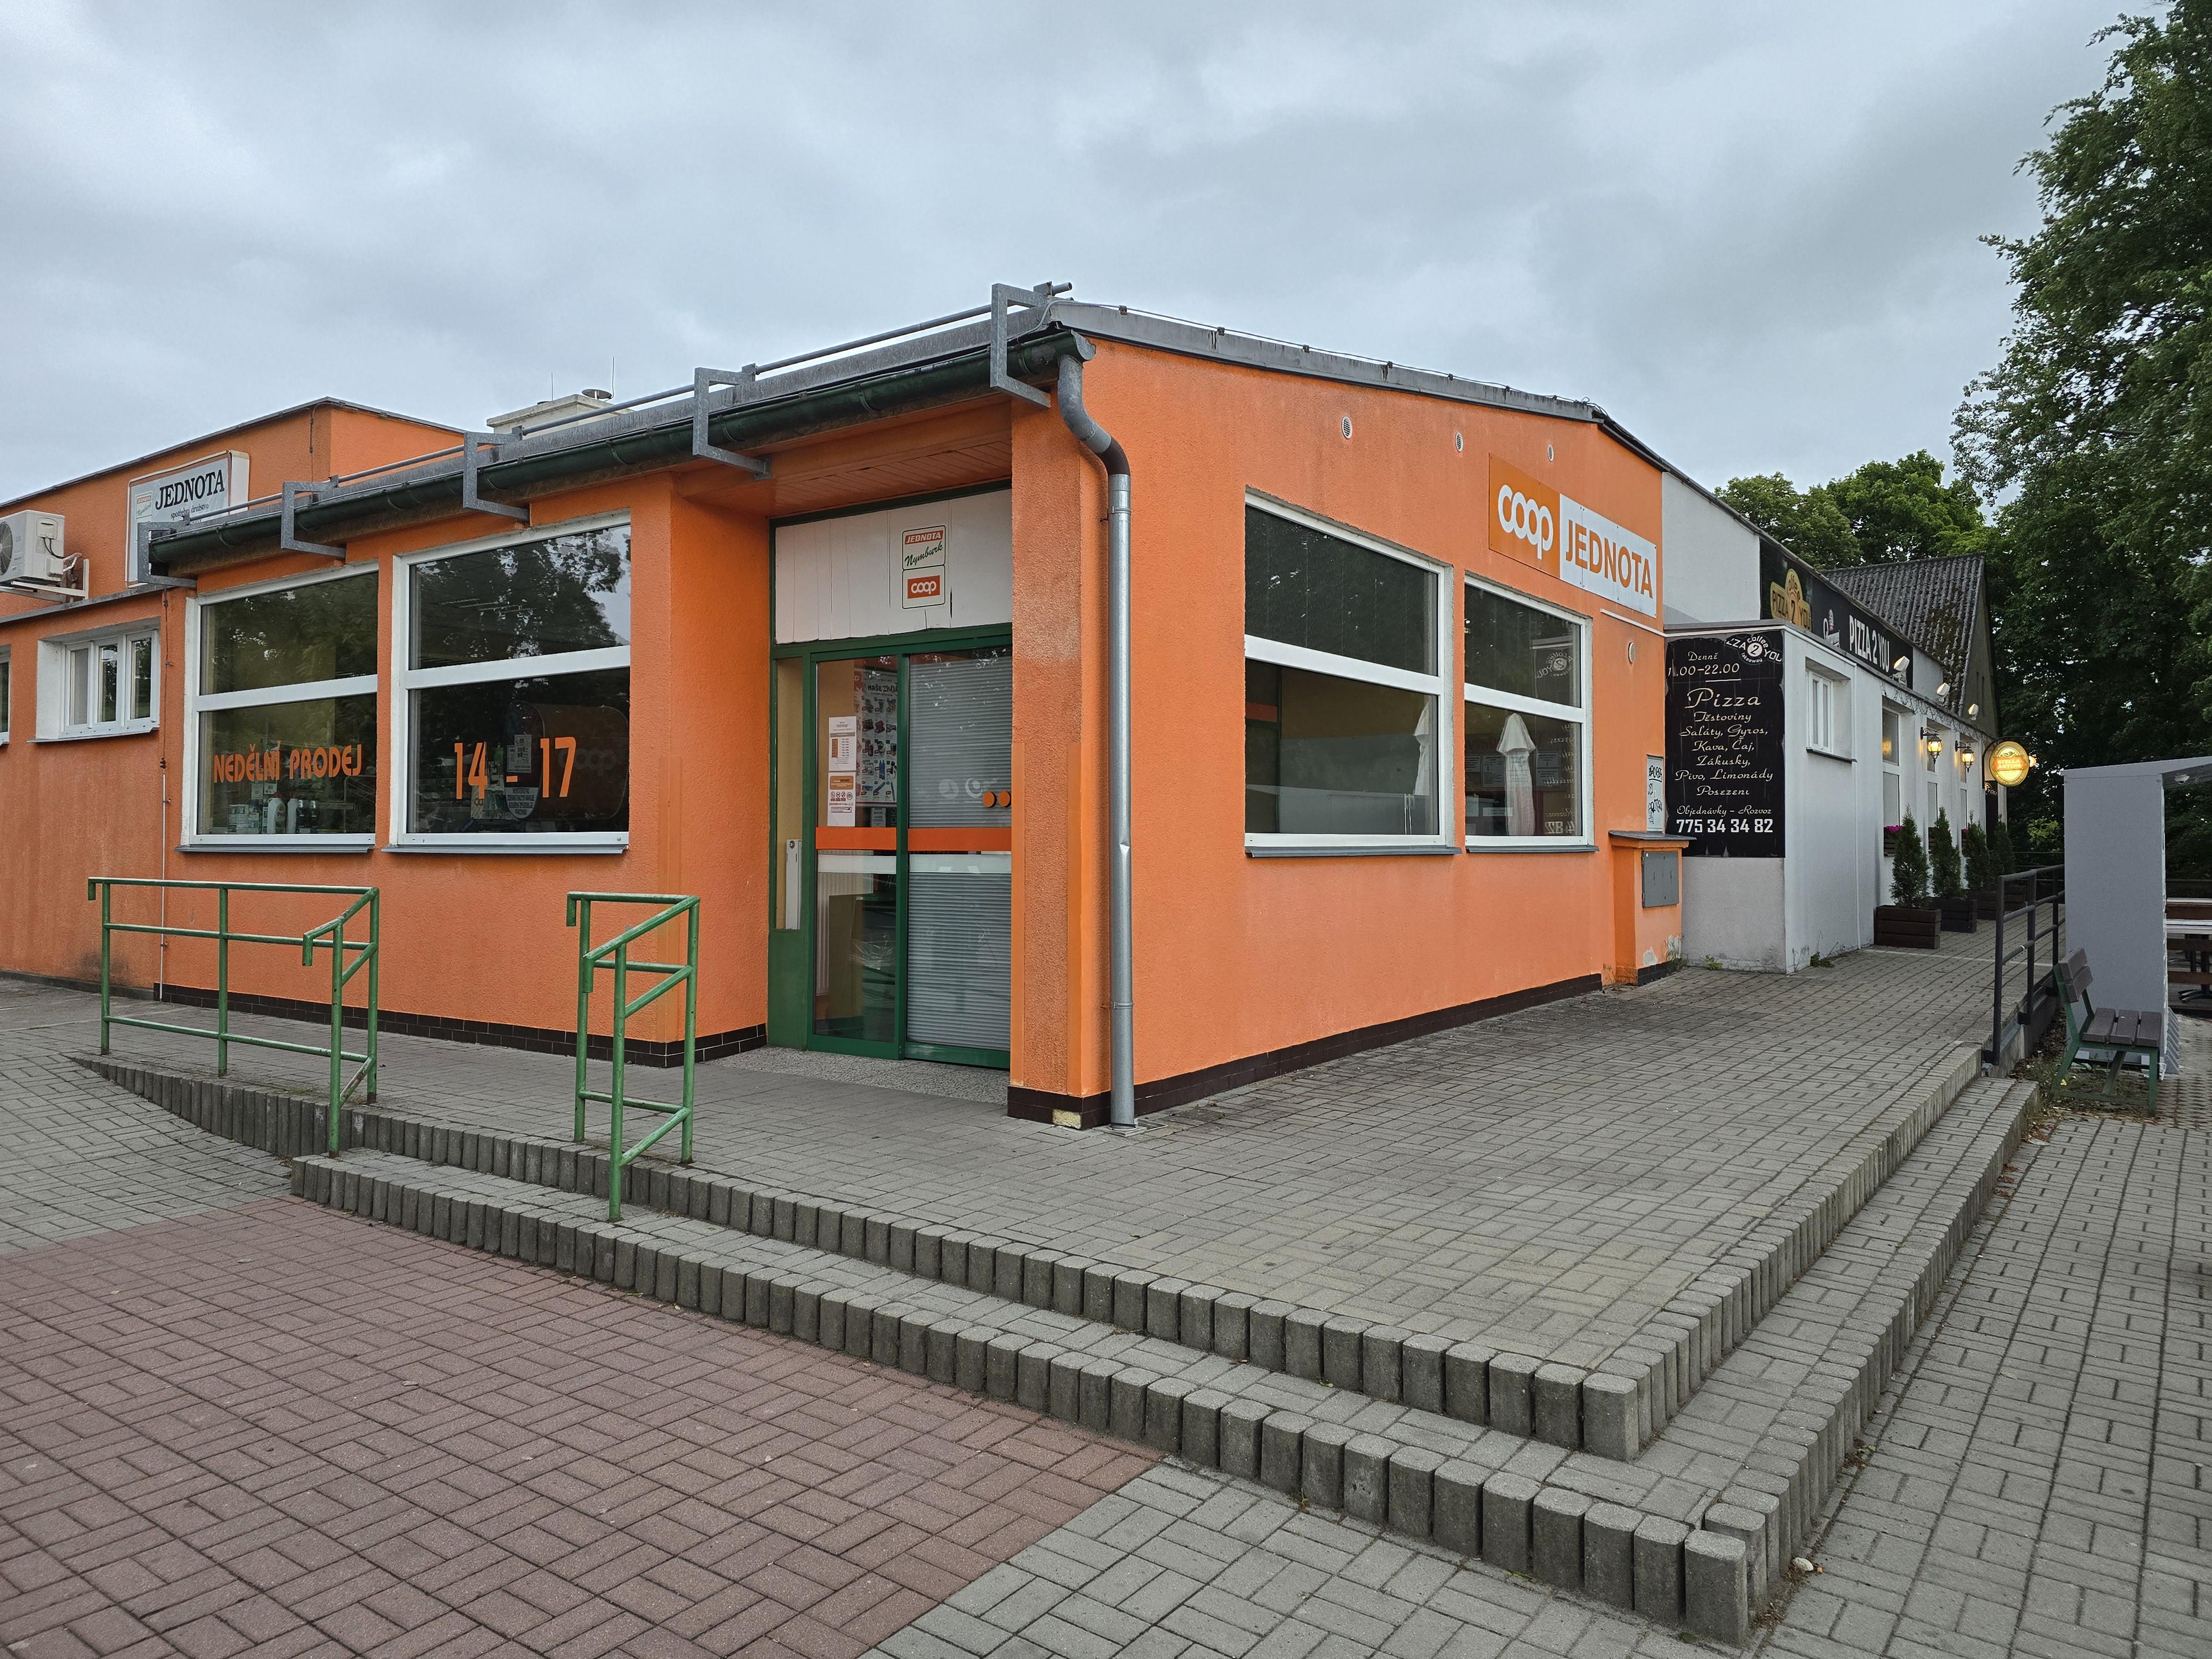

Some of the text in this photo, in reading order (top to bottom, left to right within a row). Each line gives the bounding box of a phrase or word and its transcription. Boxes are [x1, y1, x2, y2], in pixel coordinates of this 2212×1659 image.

[155, 469, 225, 510] JEDNOTA
[906, 531, 942, 544] JEDNOTA
[1498, 484, 1653, 599] coop JEDNOTA
[904, 540, 943, 567] Nymburk
[911, 580, 937, 594] coop
[1772, 589, 1811, 630] PIZZA 2 YOU
[1726, 637, 1782, 662] ZZA 2 YOU
[1849, 614, 1872, 662] PIZZA
[1872, 629, 1877, 665] 2
[1878, 633, 1890, 673] YOU
[1688, 651, 1719, 661] Denně
[1668, 663, 1740, 676] 1.00-22.00
[1684, 687, 1761, 708] Pizza
[1694, 711, 1752, 723] Těstoviny
[1679, 724, 1768, 739] Saláty, Gyros,
[1732, 735, 1755, 752] Čaj,
[213, 740, 362, 784] NEDĚLNÍ PRODEJ
[455, 742, 488, 800] 14
[540, 736, 576, 799] 17
[1695, 754, 1751, 768] Zákusky,
[1675, 770, 1706, 781] Pivo,
[1710, 768, 1773, 782] Limonády
[1677, 805, 1728, 817] Objednávky
[1738, 805, 1772, 816] Rozvoz
[1676, 818, 1773, 833] 775 34 34 82
